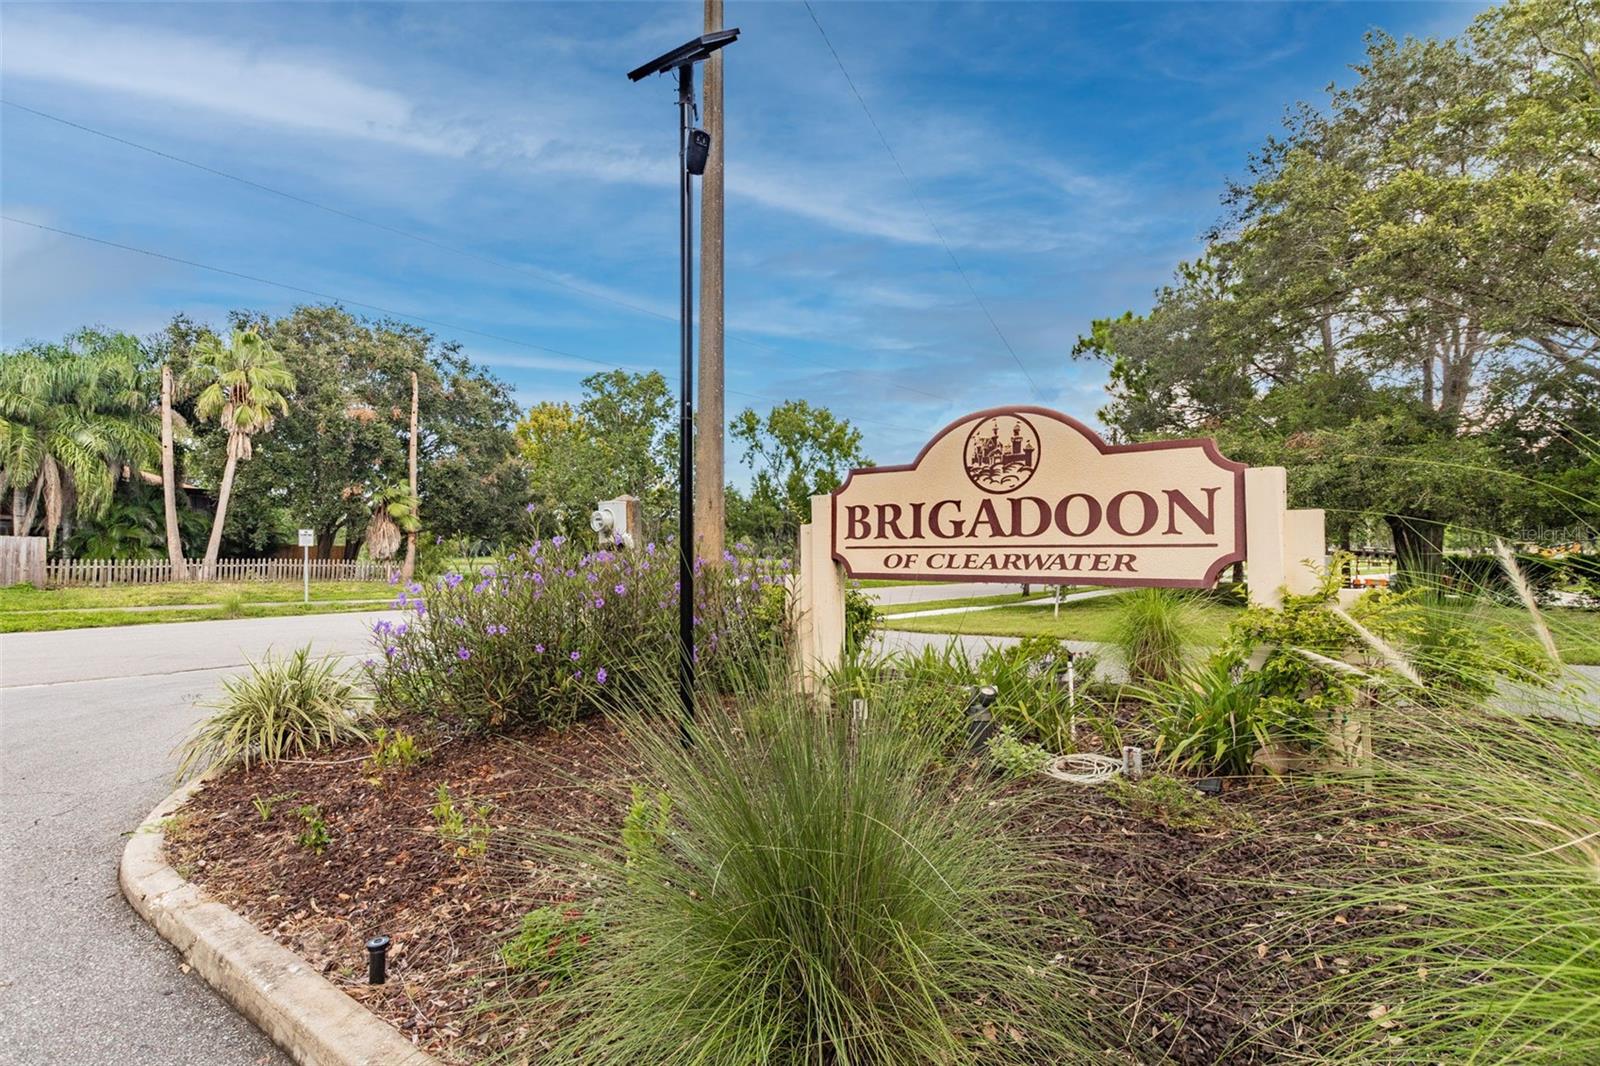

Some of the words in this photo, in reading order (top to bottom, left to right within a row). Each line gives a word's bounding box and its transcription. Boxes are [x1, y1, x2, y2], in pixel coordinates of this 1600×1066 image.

[844, 487, 1222, 541] BRIGADOON
[883, 553, 919, 570] OF
[926, 552, 1139, 573] CLEARWATER
